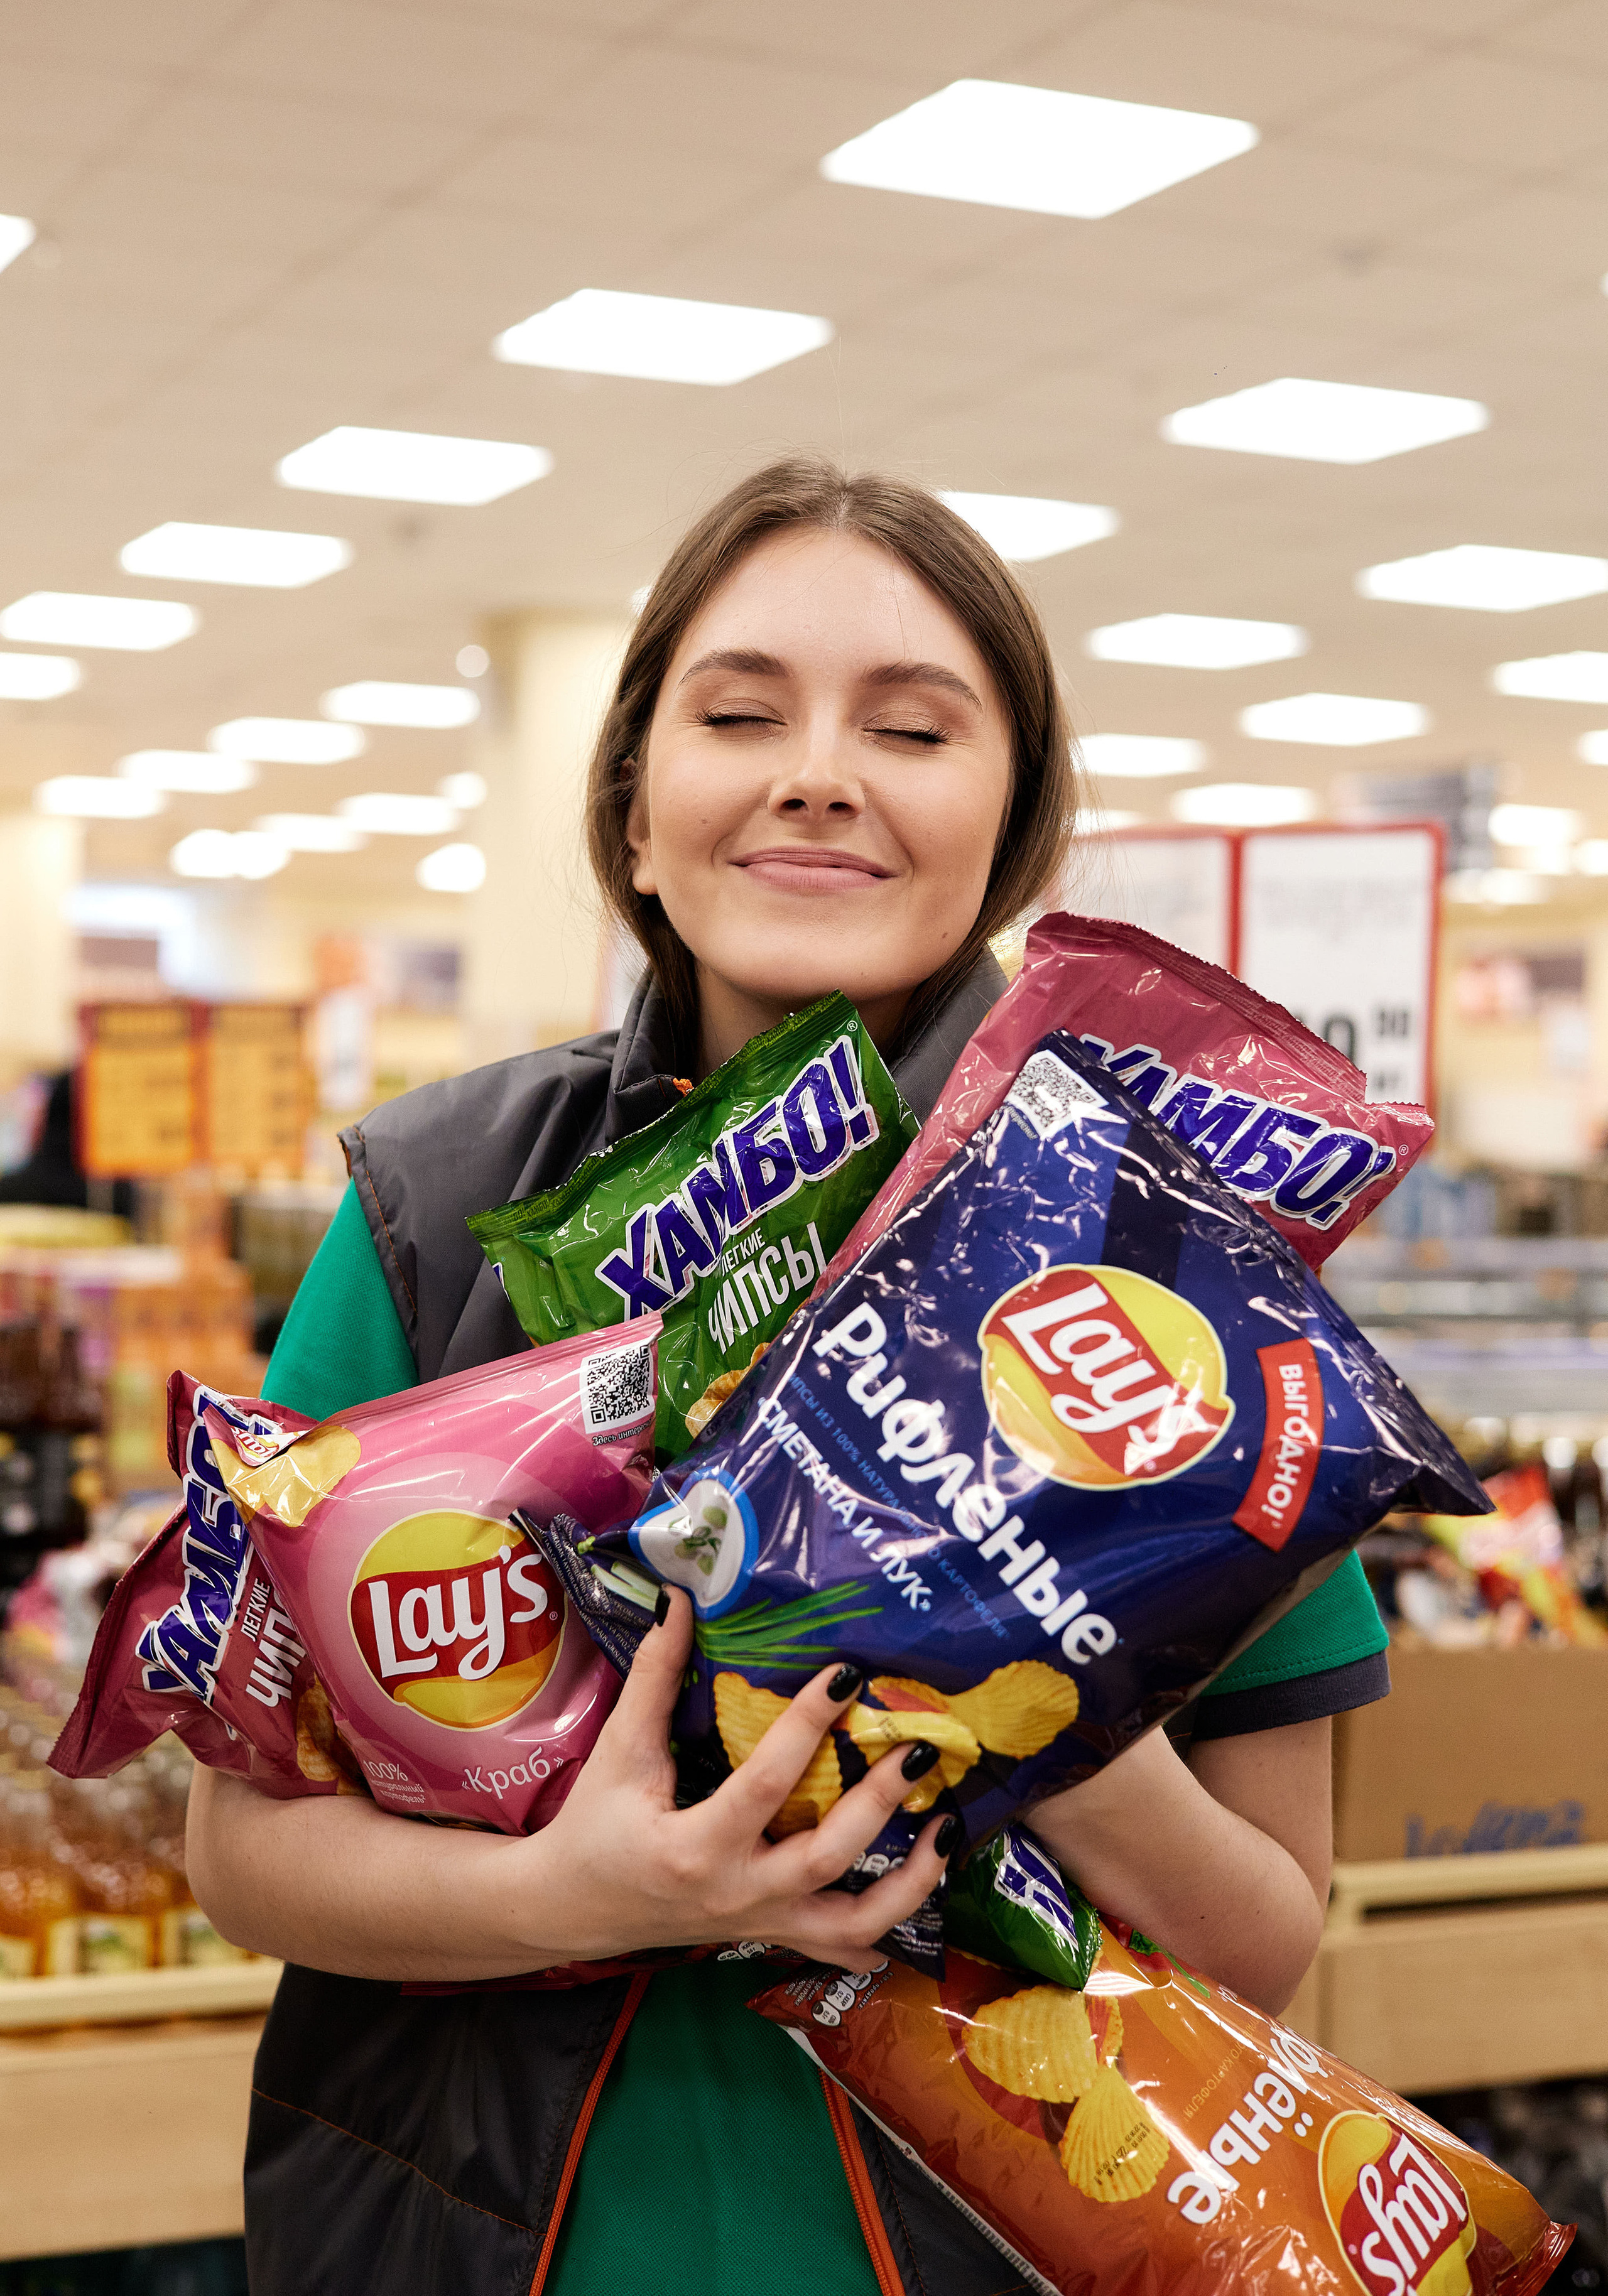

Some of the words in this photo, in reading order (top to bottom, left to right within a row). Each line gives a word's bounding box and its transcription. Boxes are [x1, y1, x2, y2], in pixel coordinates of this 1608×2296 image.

[595, 1035, 879, 1321] ХАМБО!
[708, 1221, 828, 1355] ЧИПСЫ
[719, 1227, 766, 1277] ЛЕГКИЕ
[592, 1434, 617, 1446] Здесь
[789, 1373, 820, 1411] ИПСЫ
[815, 1407, 834, 1429] ИЗ
[832, 1427, 861, 1463] 100%
[1261, 1363, 1309, 1520] ВЫГОДНО!
[852, 1516, 884, 1549] И
[241, 1578, 271, 1641] ЛЕГКИЕ
[245, 1589, 306, 1707] ЧИП
[368, 1545, 548, 1681] Lay's
[363, 1760, 408, 1782] 100%
[462, 1746, 564, 1799] «Краб»
[1166, 2025, 1329, 2225] флёные
